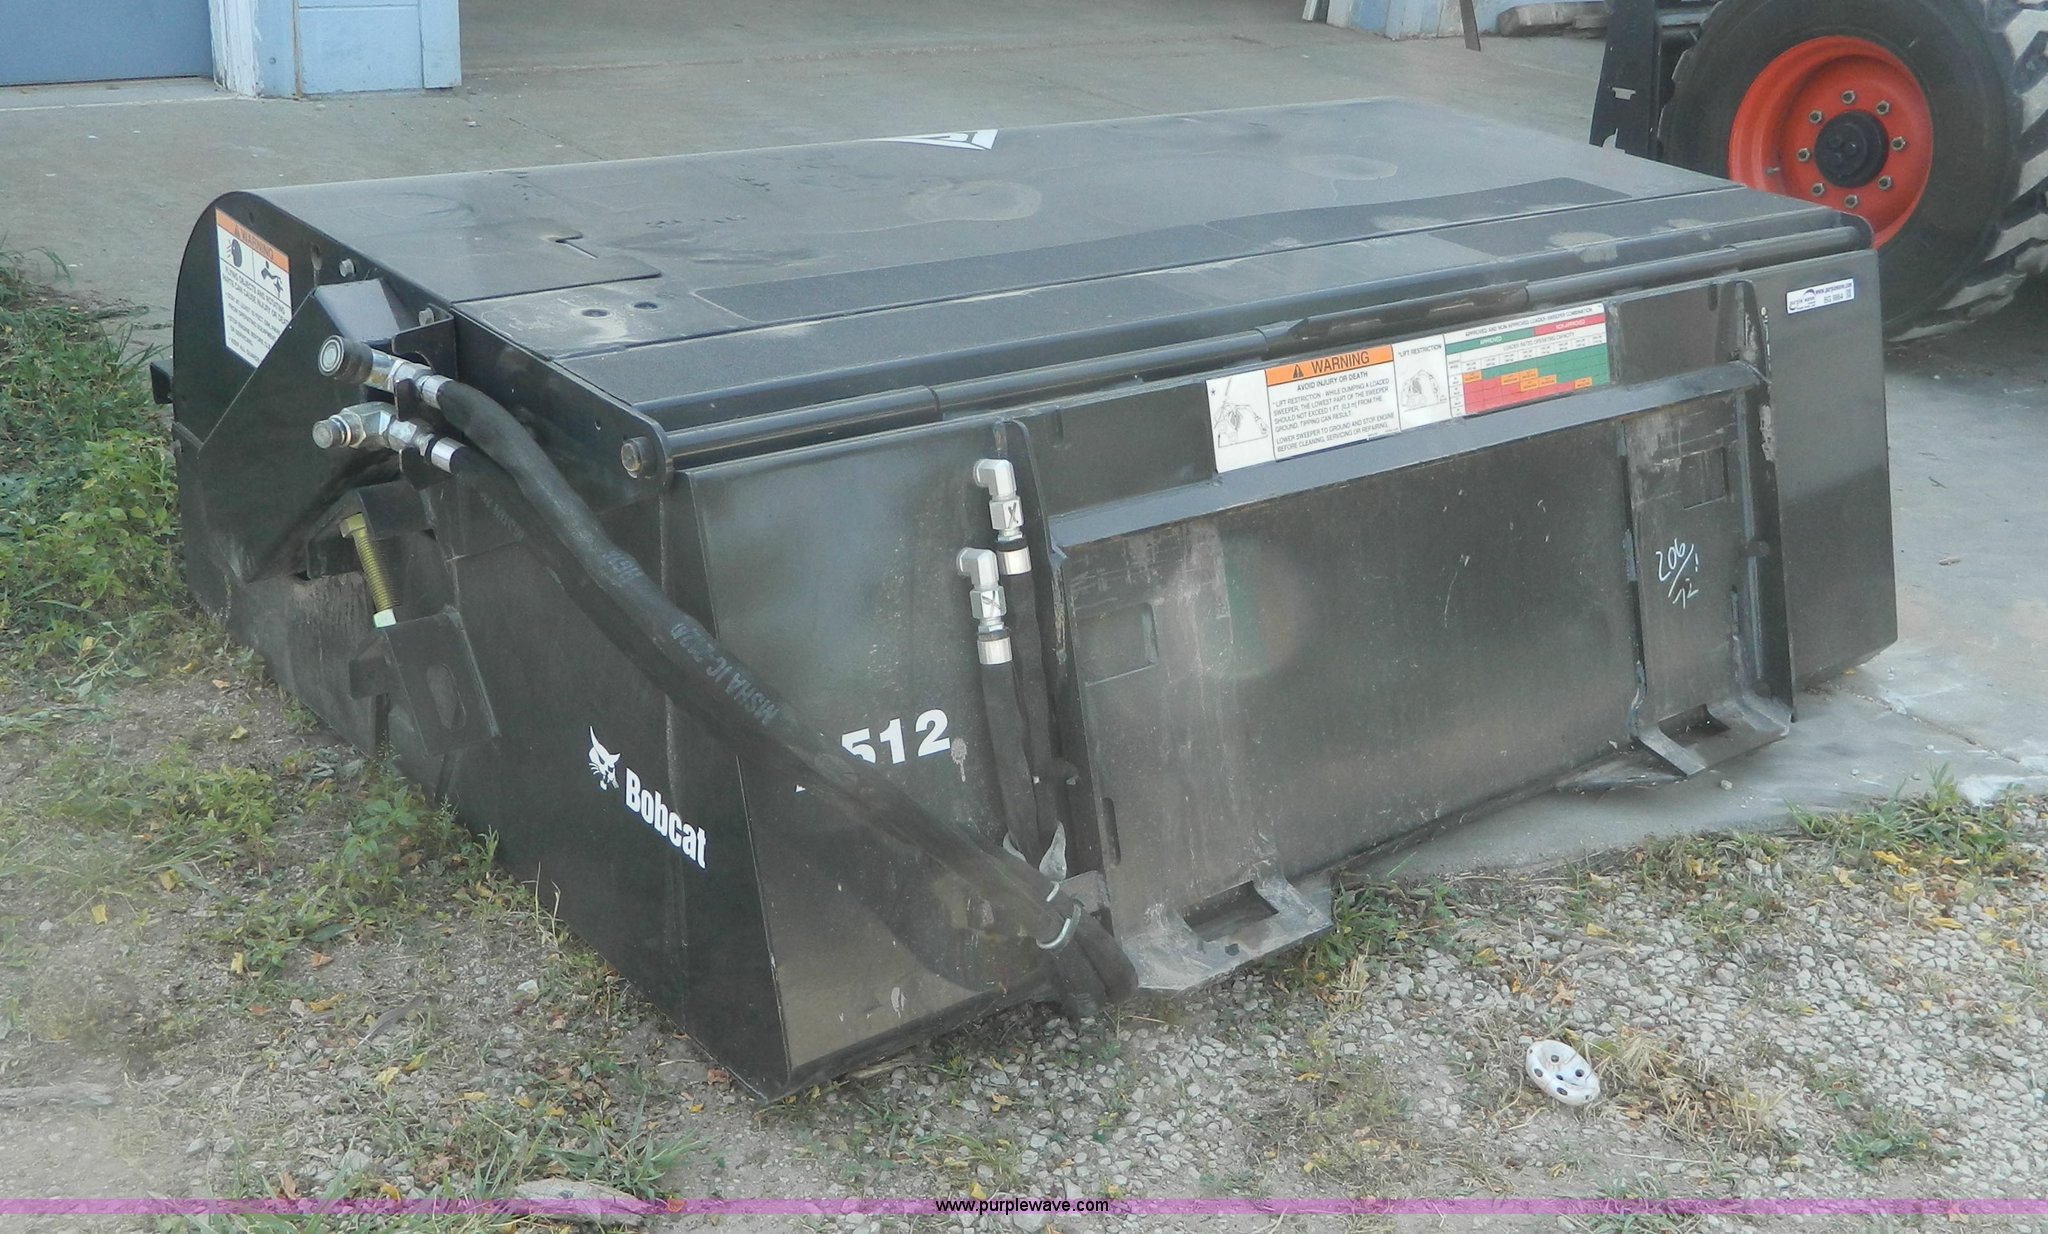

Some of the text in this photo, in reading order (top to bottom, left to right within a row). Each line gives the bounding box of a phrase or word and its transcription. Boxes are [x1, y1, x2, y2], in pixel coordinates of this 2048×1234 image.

[241, 231, 274, 259] WARNING
[1410, 344, 1442, 355] RESTRICTION
[1311, 351, 1370, 374] WARNING
[1287, 393, 1321, 404] RESTRICTION
[1341, 384, 1365, 393] DUMPING
[1369, 379, 1390, 387] LOADED
[1297, 382, 1316, 391] AVOID
[1316, 378, 1338, 387] INJURY
[1349, 372, 1368, 381] DEATH
[1311, 399, 1332, 408] LOWEST
[1365, 387, 1389, 396] SWEEPER
[1274, 415, 1296, 424] SHOULD
[1308, 408, 1329, 417] EXCEED
[1357, 399, 1373, 407] FROM
[1300, 419, 1320, 427] TIPPING
[1276, 436, 1295, 445] LOWER
[1296, 430, 1321, 440] SWEEPER
[1329, 423, 1350, 433] GROUND
[1351, 420, 1362, 428] AND
[1363, 417, 1376, 425] STOP
[1376, 413, 1394, 422] ENGINE
[1277, 443, 1299, 453] BEFORE
[1326, 431, 1352, 441] SERVICING
[841, 709, 951, 766] 512
[625, 768, 707, 870] Bobcat
